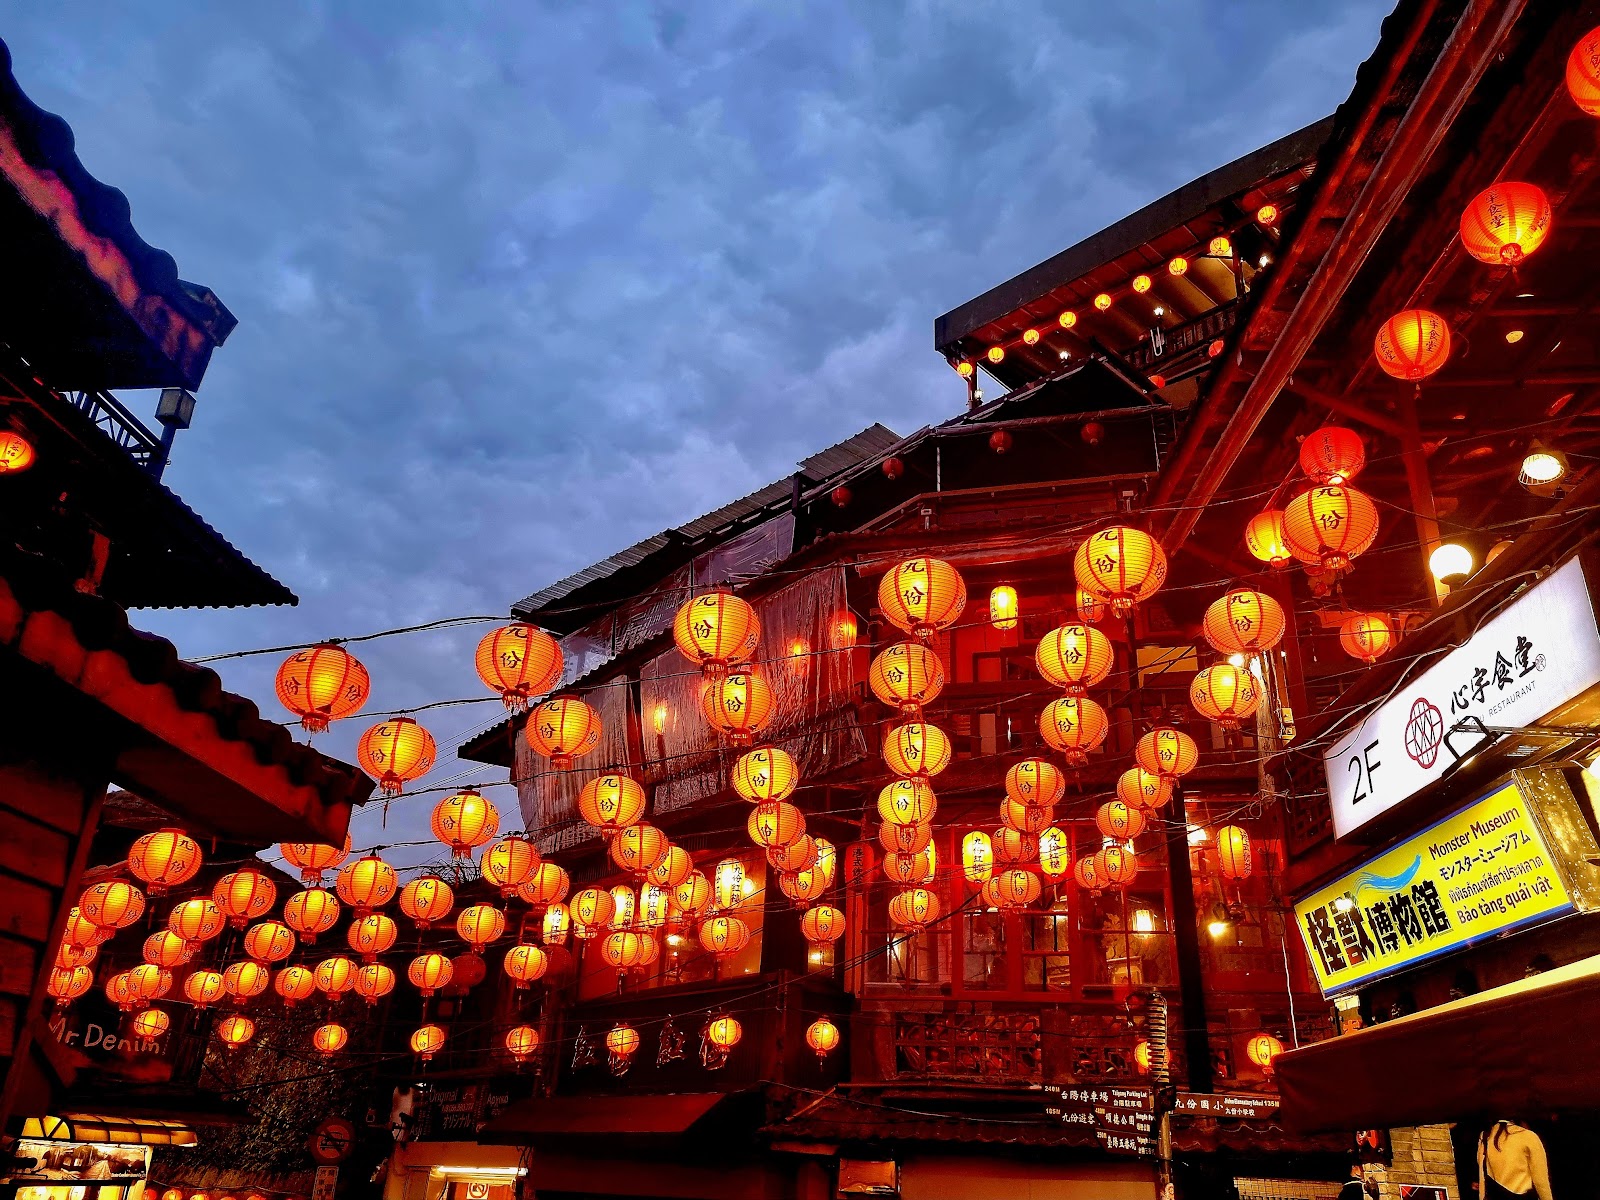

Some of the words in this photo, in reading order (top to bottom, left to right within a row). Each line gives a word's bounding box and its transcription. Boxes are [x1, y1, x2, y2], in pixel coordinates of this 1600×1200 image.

[1316, 486, 1345, 531] 九份
[1095, 528, 1118, 574] 九份
[903, 561, 925, 606] 九份
[694, 596, 716, 639] 九份
[1231, 594, 1253, 632] 九份
[501, 627, 528, 669] 九份
[1063, 626, 1084, 664] 九份
[284, 652, 308, 696] 九份
[887, 646, 904, 683] 九份
[725, 676, 745, 713] 九份
[1488, 680, 1536, 717] RESTAURANT
[540, 701, 559, 738] 九份
[1058, 698, 1076, 733] 九份
[370, 726, 392, 764] 九份
[903, 726, 920, 760] 九份
[1159, 731, 1175, 761] 九份
[752, 753, 767, 787] 九份
[1019, 763, 1033, 794] 九份
[1348, 739, 1381, 806] 2F
[442, 797, 461, 830] 九份
[600, 778, 618, 812] 九份
[897, 781, 911, 811] 九份
[623, 829, 636, 859] 九份
[1429, 829, 1471, 860] Monster
[1470, 807, 1520, 839] Museum
[493, 845, 507, 875] 九份
[1440, 830, 1531, 880] モンスターミュージアム
[417, 881, 433, 908] 九份
[1457, 902, 1478, 924] Bảo
[1478, 897, 1507, 919] tàng
[1506, 882, 1532, 912] quái
[1532, 876, 1553, 899] vật
[1304, 879, 1453, 976] 怪獸博物館
[1061, 1090, 1109, 1102] 台陽停車場
